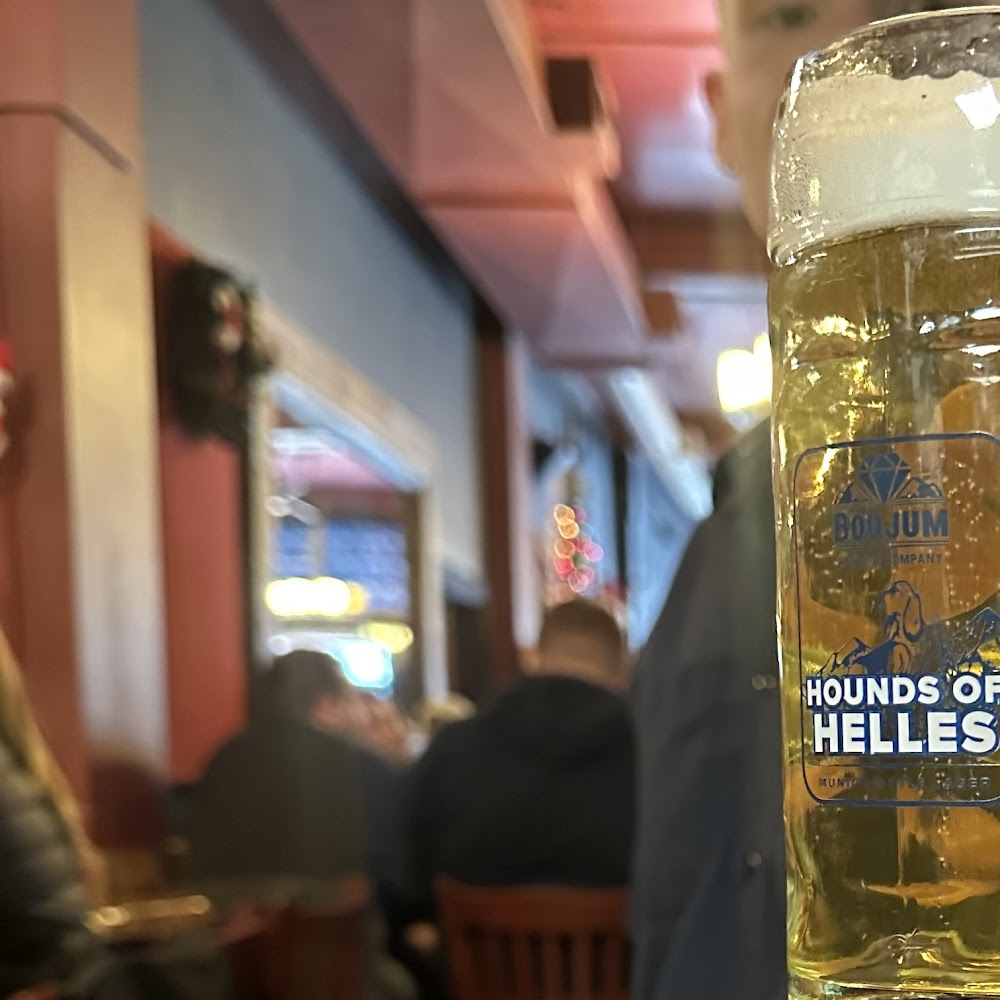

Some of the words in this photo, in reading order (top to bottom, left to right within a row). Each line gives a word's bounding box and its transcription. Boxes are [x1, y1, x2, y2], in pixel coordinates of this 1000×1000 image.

[834, 509, 948, 543] BOOJUM
[806, 674, 941, 707] HOUNDS
[813, 710, 997, 754] HELLES
